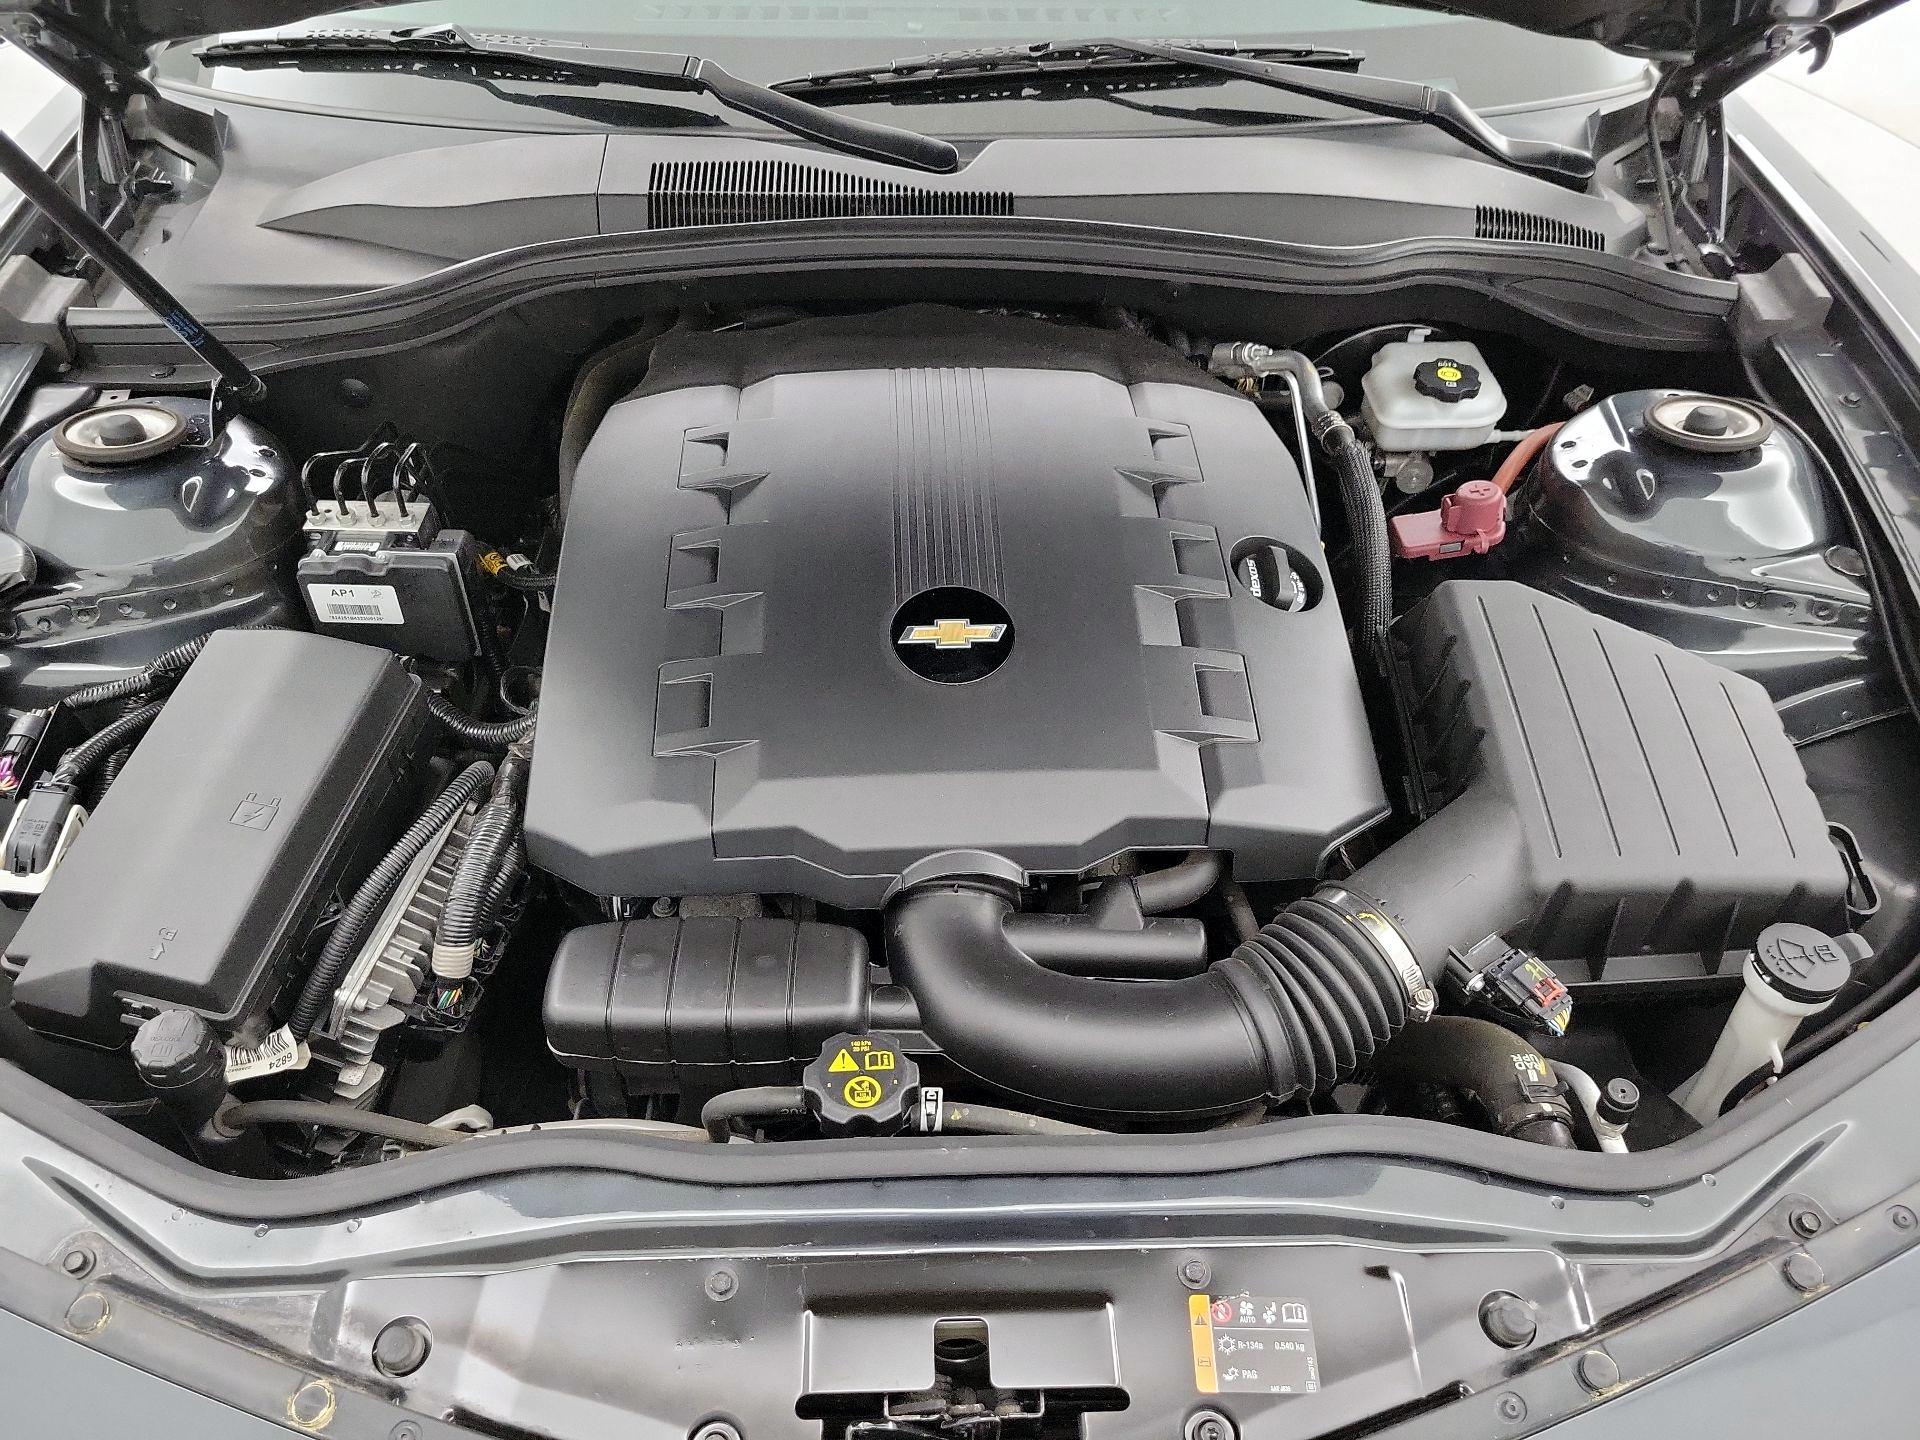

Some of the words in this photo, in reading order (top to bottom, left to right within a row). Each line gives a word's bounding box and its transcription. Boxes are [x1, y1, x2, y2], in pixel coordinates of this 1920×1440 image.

[1246, 557, 1262, 598] dexos
[331, 589, 355, 598] AP1
[268, 1052, 293, 1071] 6824
[1240, 1315, 1256, 1324] AUTO
[1238, 1341, 1264, 1351] R-134a
[1274, 1341, 1294, 1351] 0.540
[1295, 1342, 1305, 1352] kg
[1242, 1369, 1258, 1379] PAG
